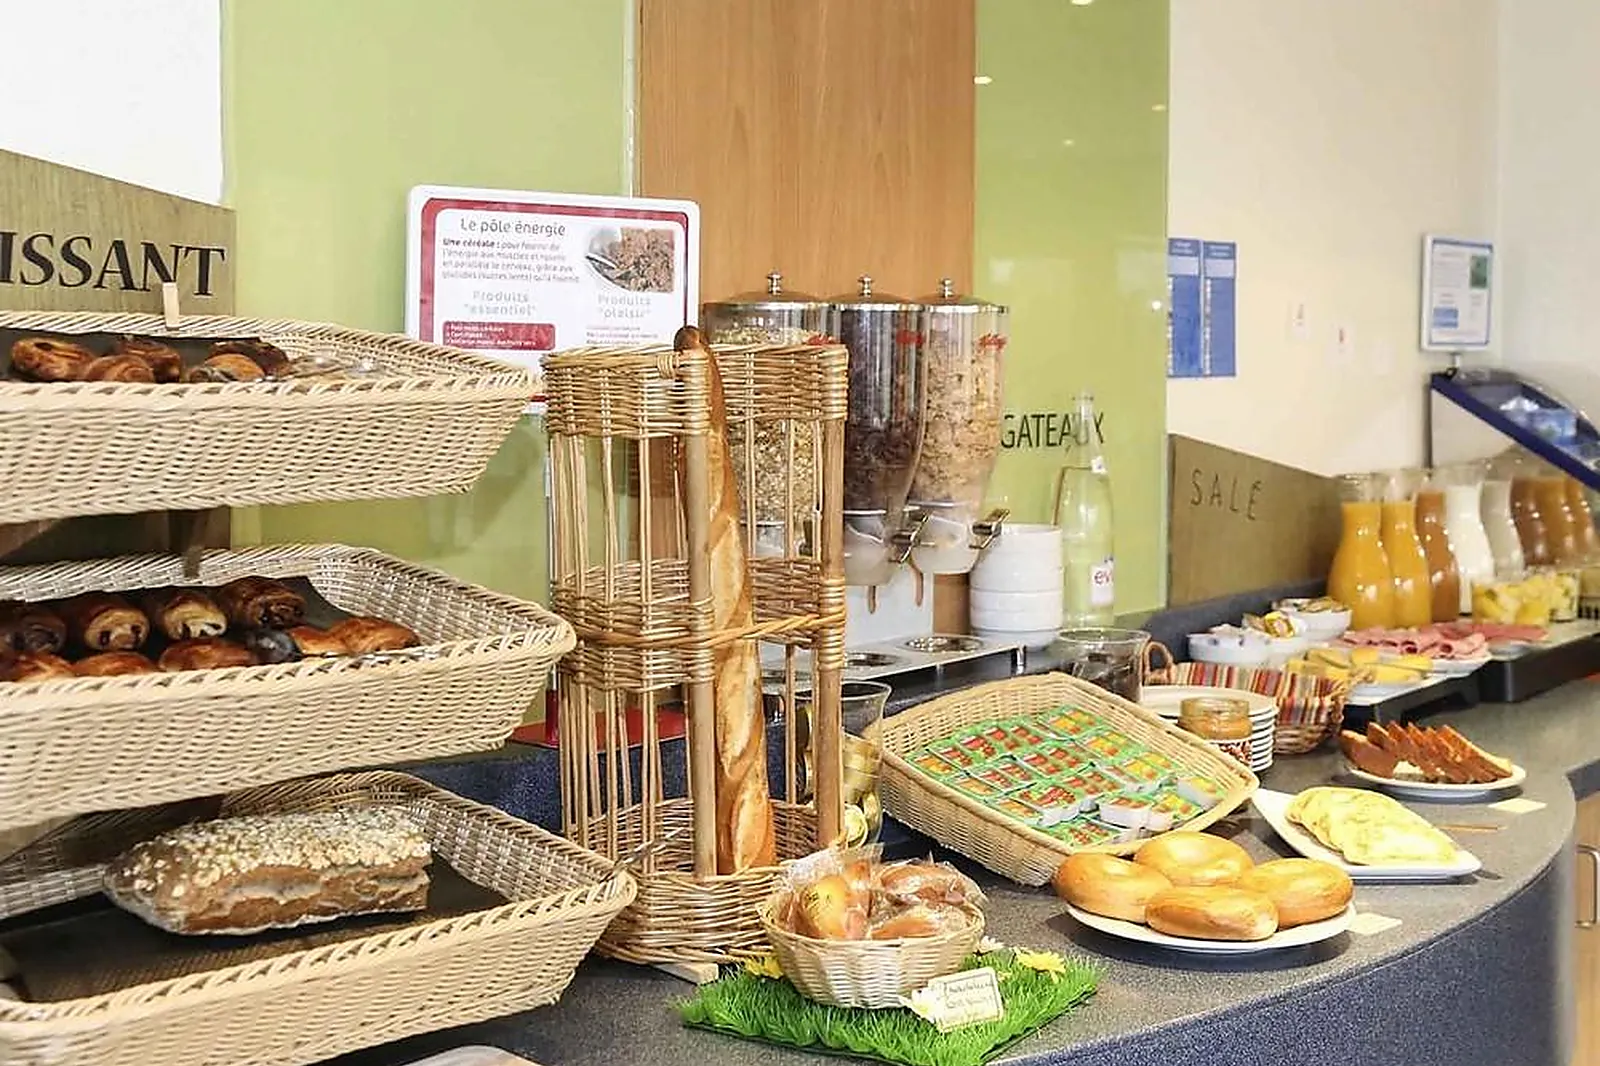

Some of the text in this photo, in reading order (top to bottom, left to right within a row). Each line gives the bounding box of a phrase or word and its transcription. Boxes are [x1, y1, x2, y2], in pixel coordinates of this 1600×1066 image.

[461, 218, 566, 237] Le pôle énergie
[443, 238, 461, 246] Une
[0, 232, 225, 296] ISSANT
[472, 290, 529, 302] Produits
[1001, 411, 1104, 449] GATEAUX
